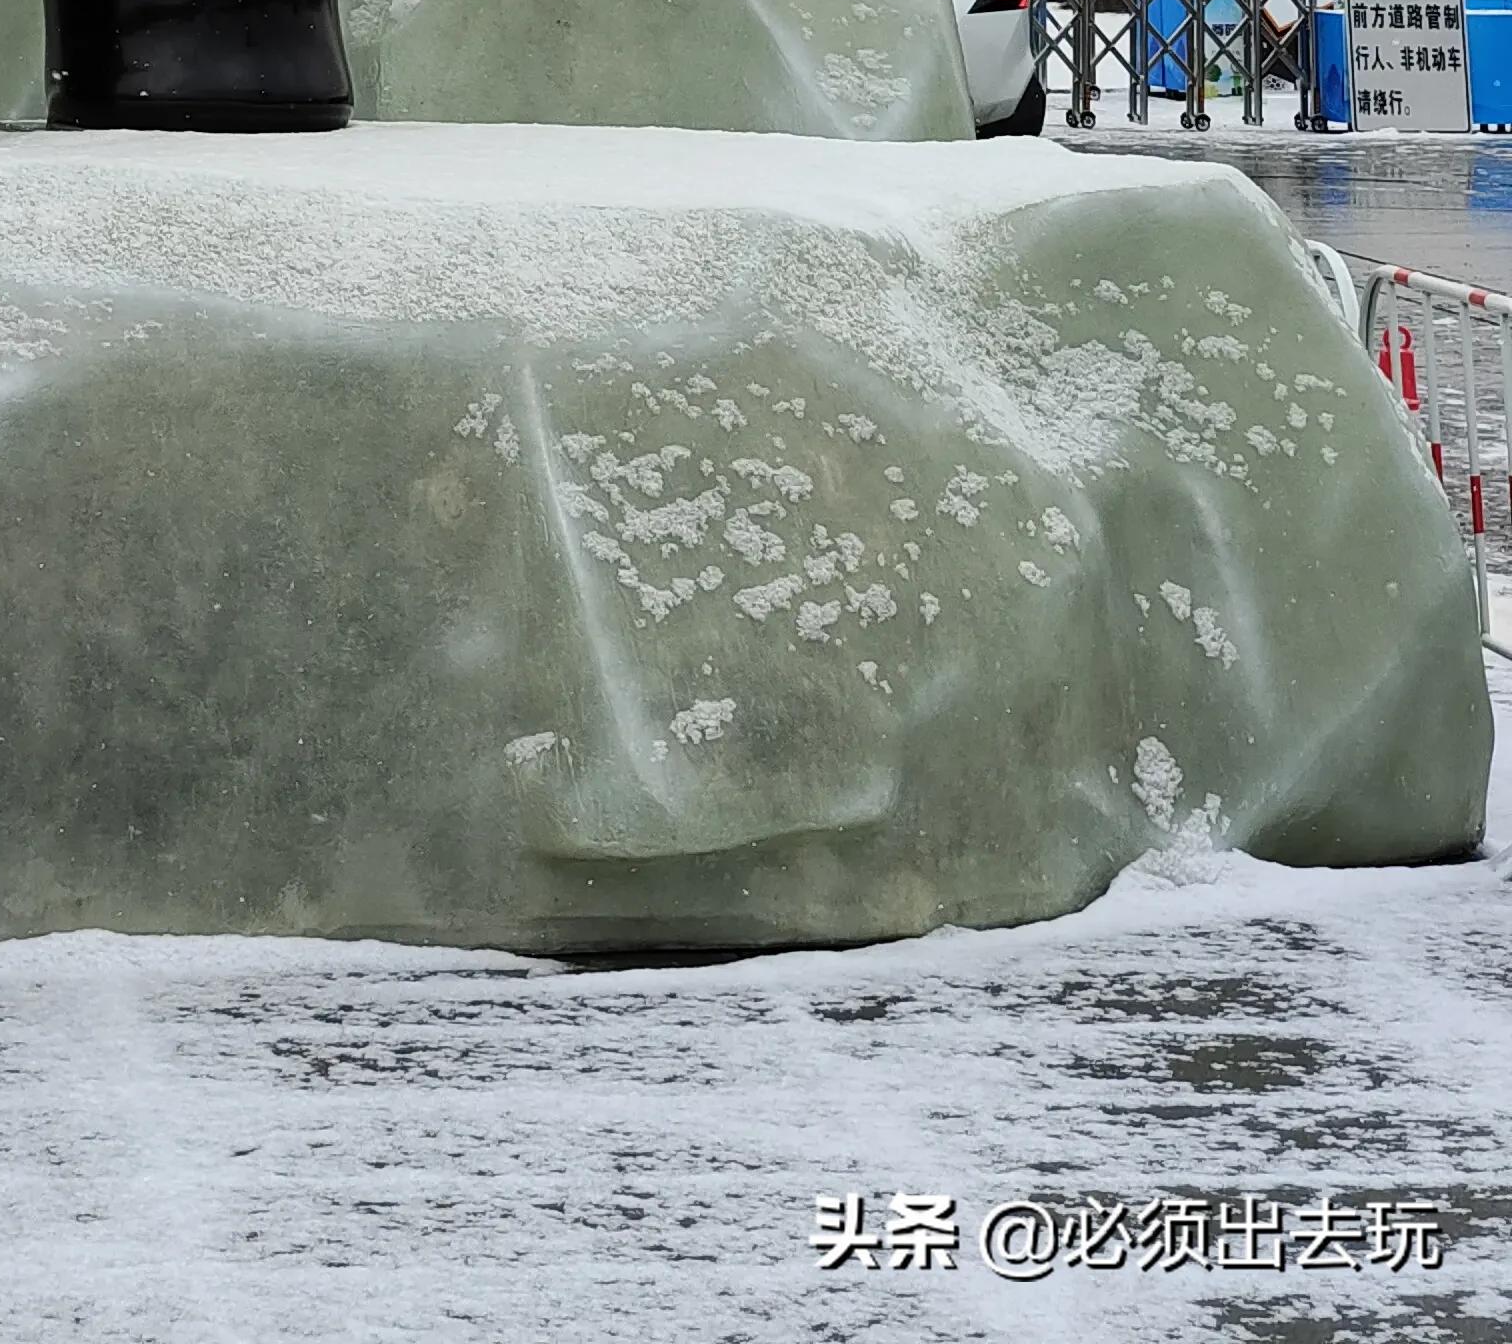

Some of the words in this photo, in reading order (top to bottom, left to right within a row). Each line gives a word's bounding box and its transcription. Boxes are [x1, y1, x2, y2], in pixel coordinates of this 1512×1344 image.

[1351, 3, 1460, 30] 前方道路管制
[1355, 45, 1462, 73] 行人、非机动车
[1357, 89, 1411, 117] 请绕行。
